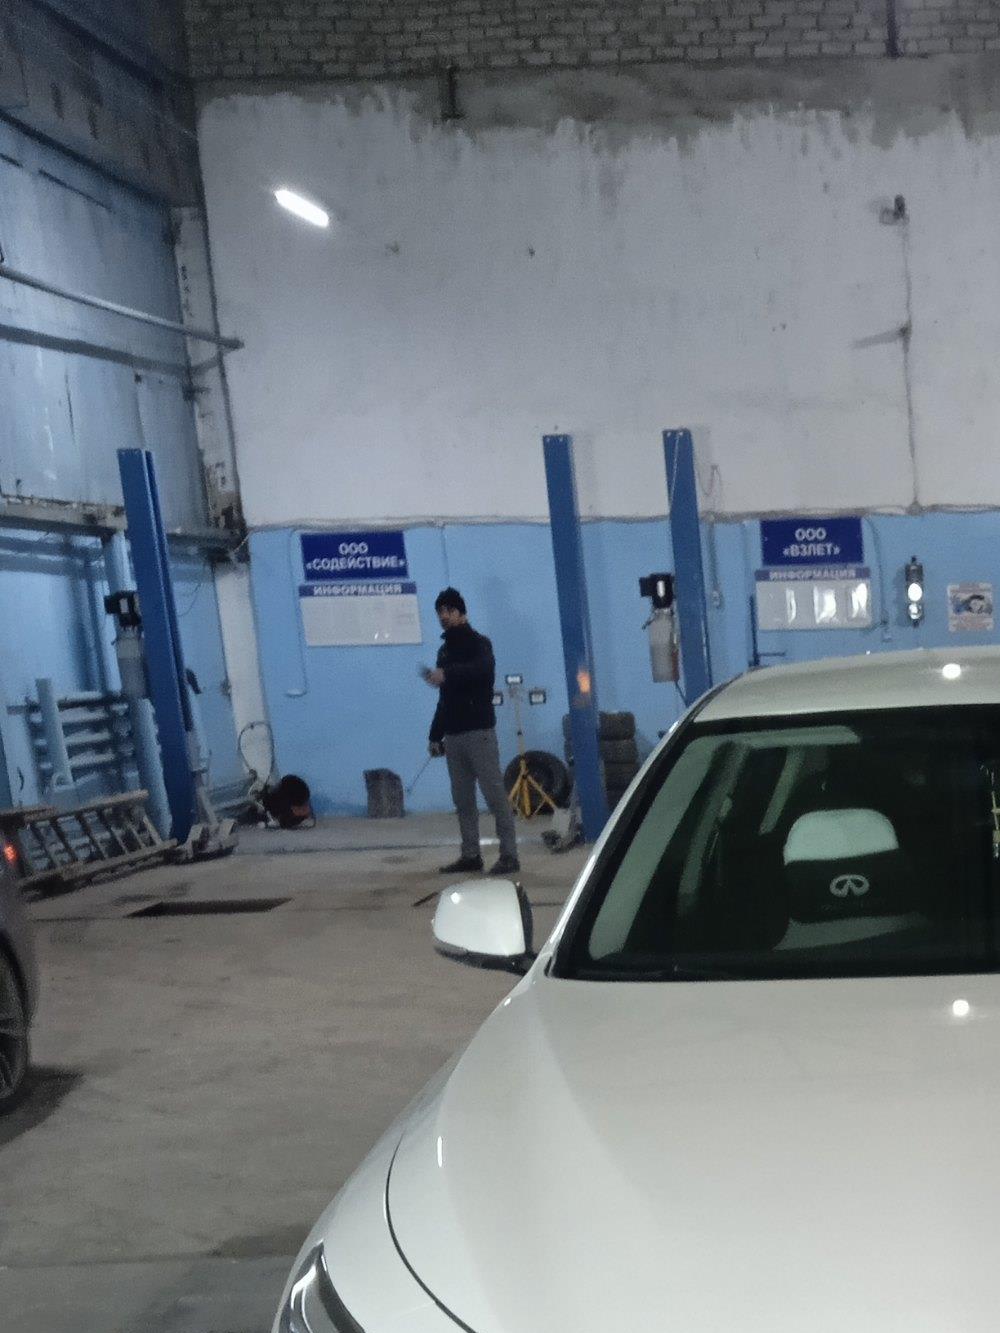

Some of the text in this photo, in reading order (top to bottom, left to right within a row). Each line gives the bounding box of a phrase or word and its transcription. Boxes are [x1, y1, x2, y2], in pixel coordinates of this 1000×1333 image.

[795, 528, 826, 542] ООО
[338, 542, 368, 555] ООО
[783, 543, 841, 557] «ВЗЛЕТ»
[306, 556, 405, 570] «СОДЕЙСТВИЕ»
[769, 569, 856, 581] ИНФОРМАЦИЯ
[313, 583, 402, 596] ИНФОРМАЦИЯ
